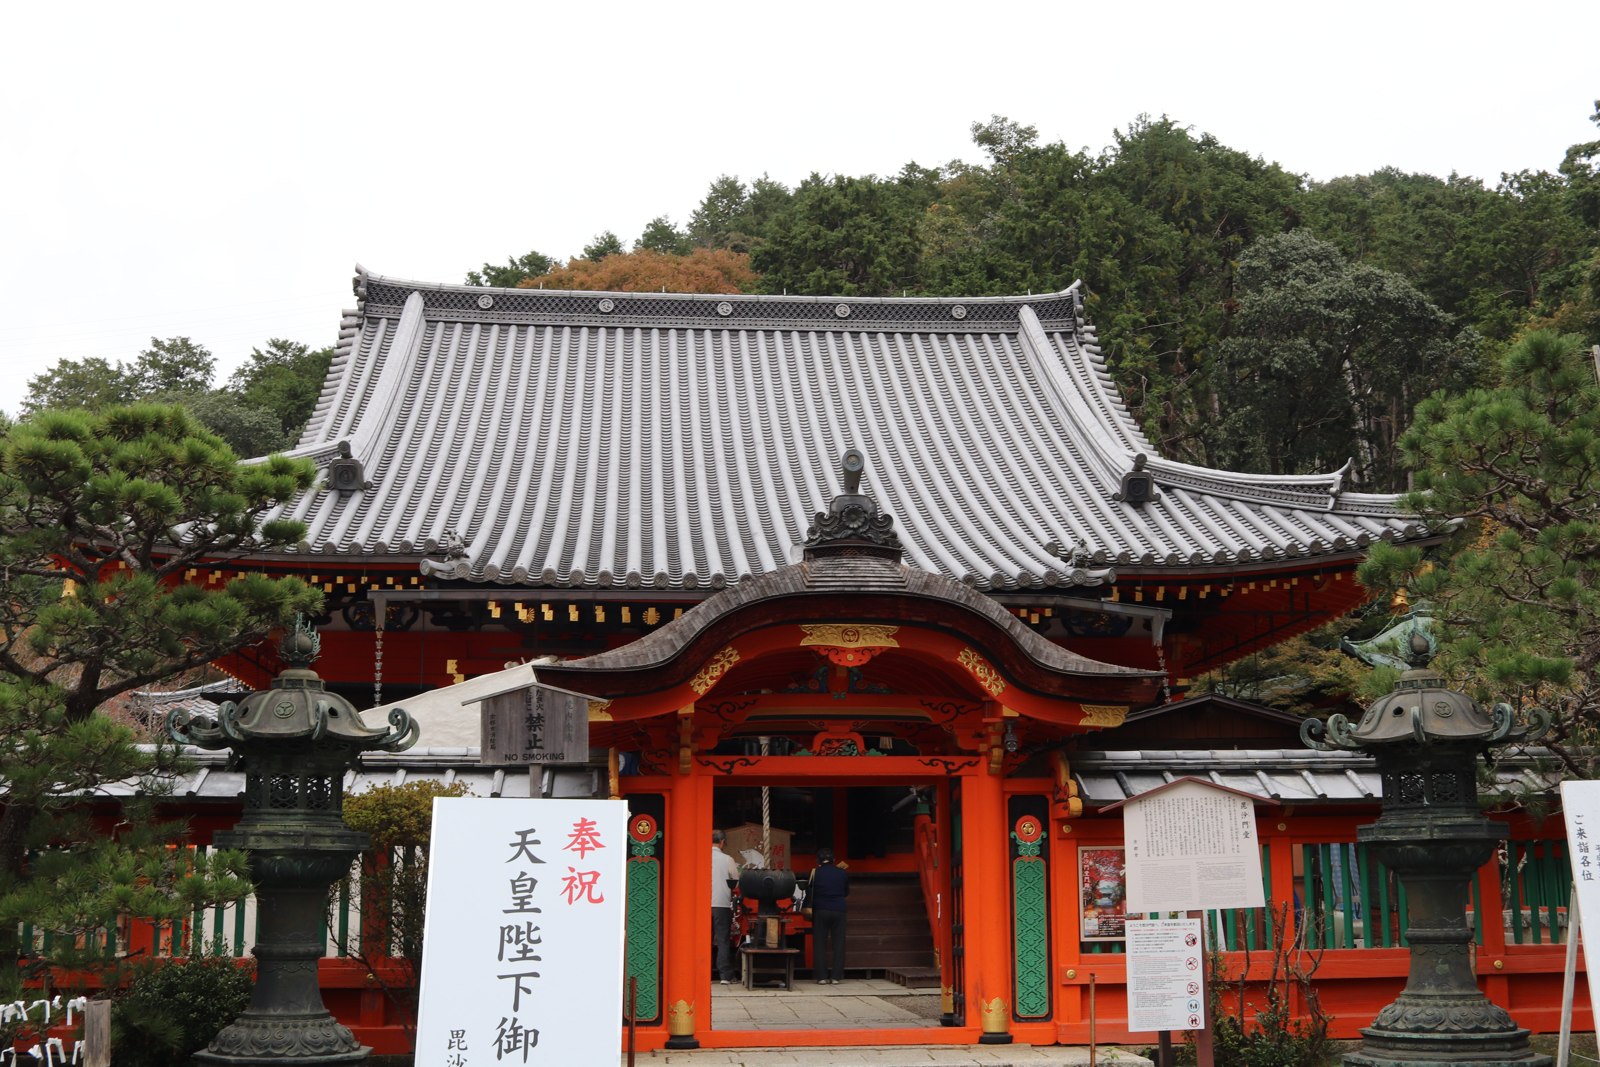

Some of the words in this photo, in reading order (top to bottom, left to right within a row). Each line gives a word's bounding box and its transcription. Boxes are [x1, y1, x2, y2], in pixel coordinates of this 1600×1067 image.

[504, 753, 519, 761] NO
[522, 752, 565, 761] SMOKING
[525, 713, 545, 751] 禁止
[560, 817, 606, 906] 奉祝
[1574, 814, 1595, 881] ご来詣各位
[491, 827, 547, 1064] 天皇陛下御
